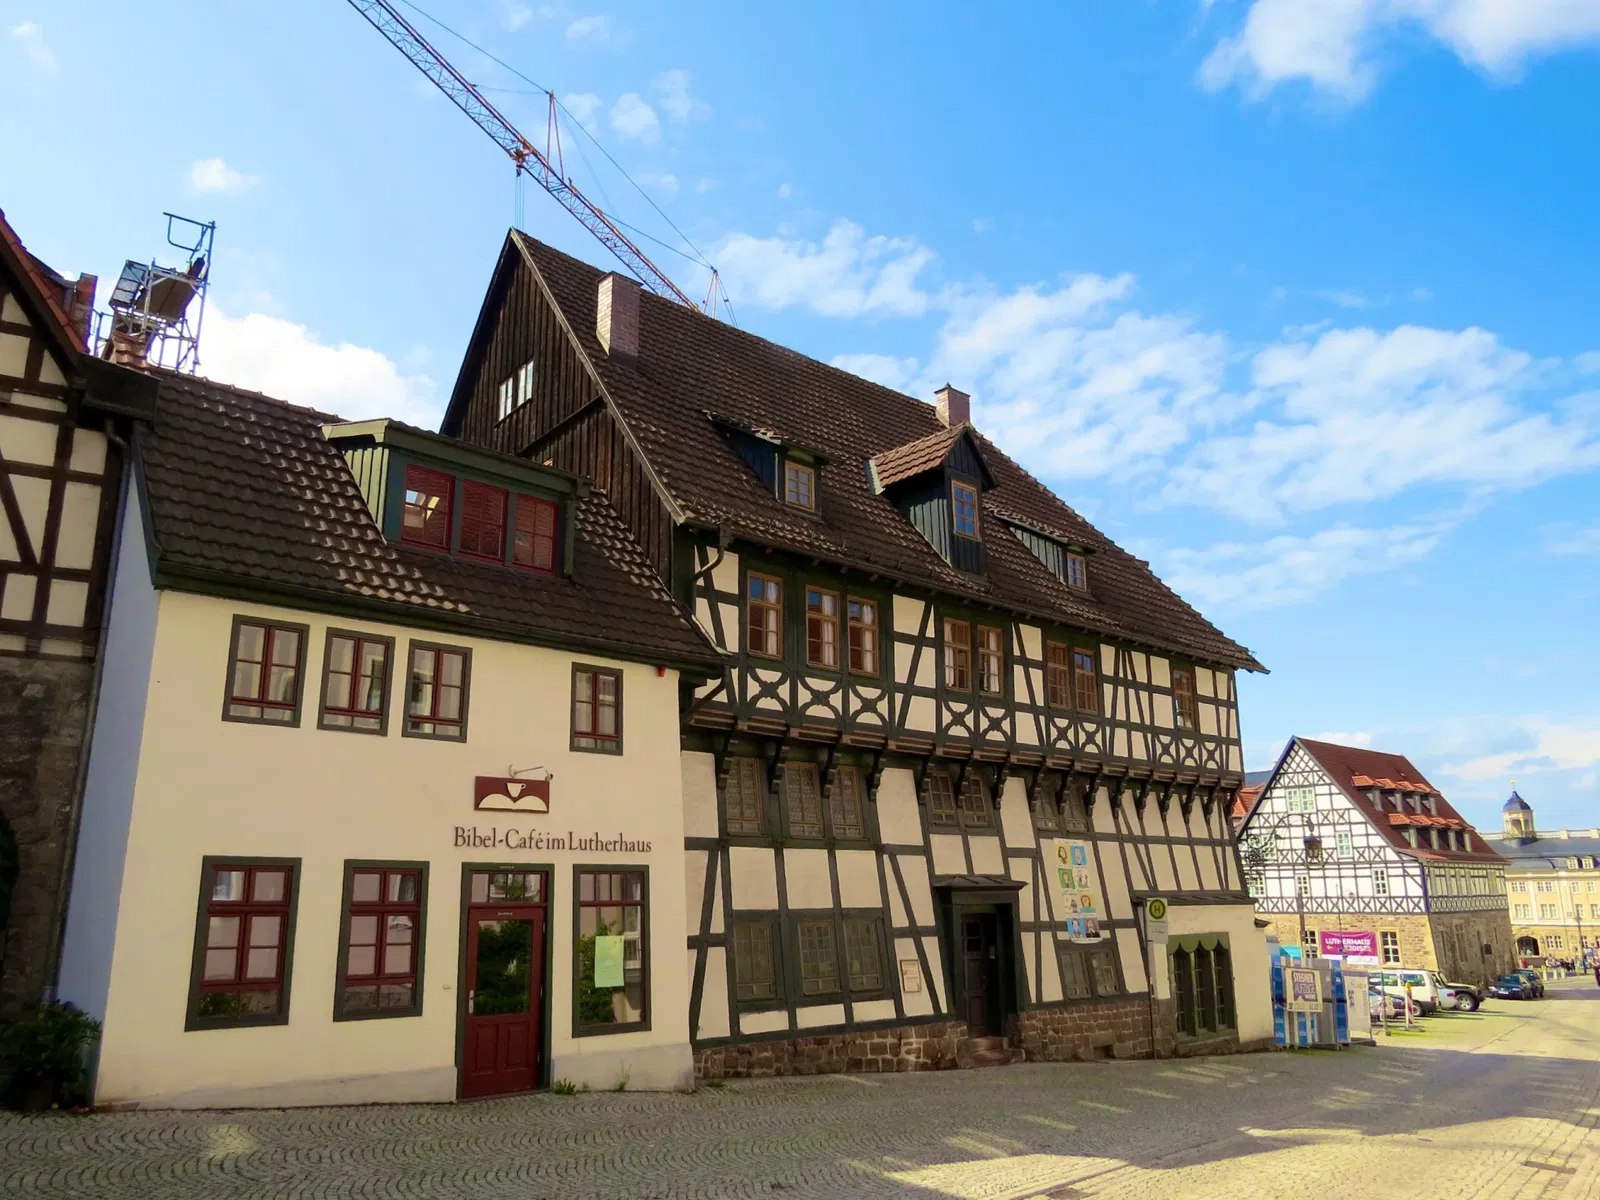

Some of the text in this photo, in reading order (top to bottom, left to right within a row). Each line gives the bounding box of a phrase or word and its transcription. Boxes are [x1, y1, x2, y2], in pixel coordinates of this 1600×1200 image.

[453, 826, 652, 852] Bibel-Café im Lutherhaus
[1154, 904, 1161, 914] H
